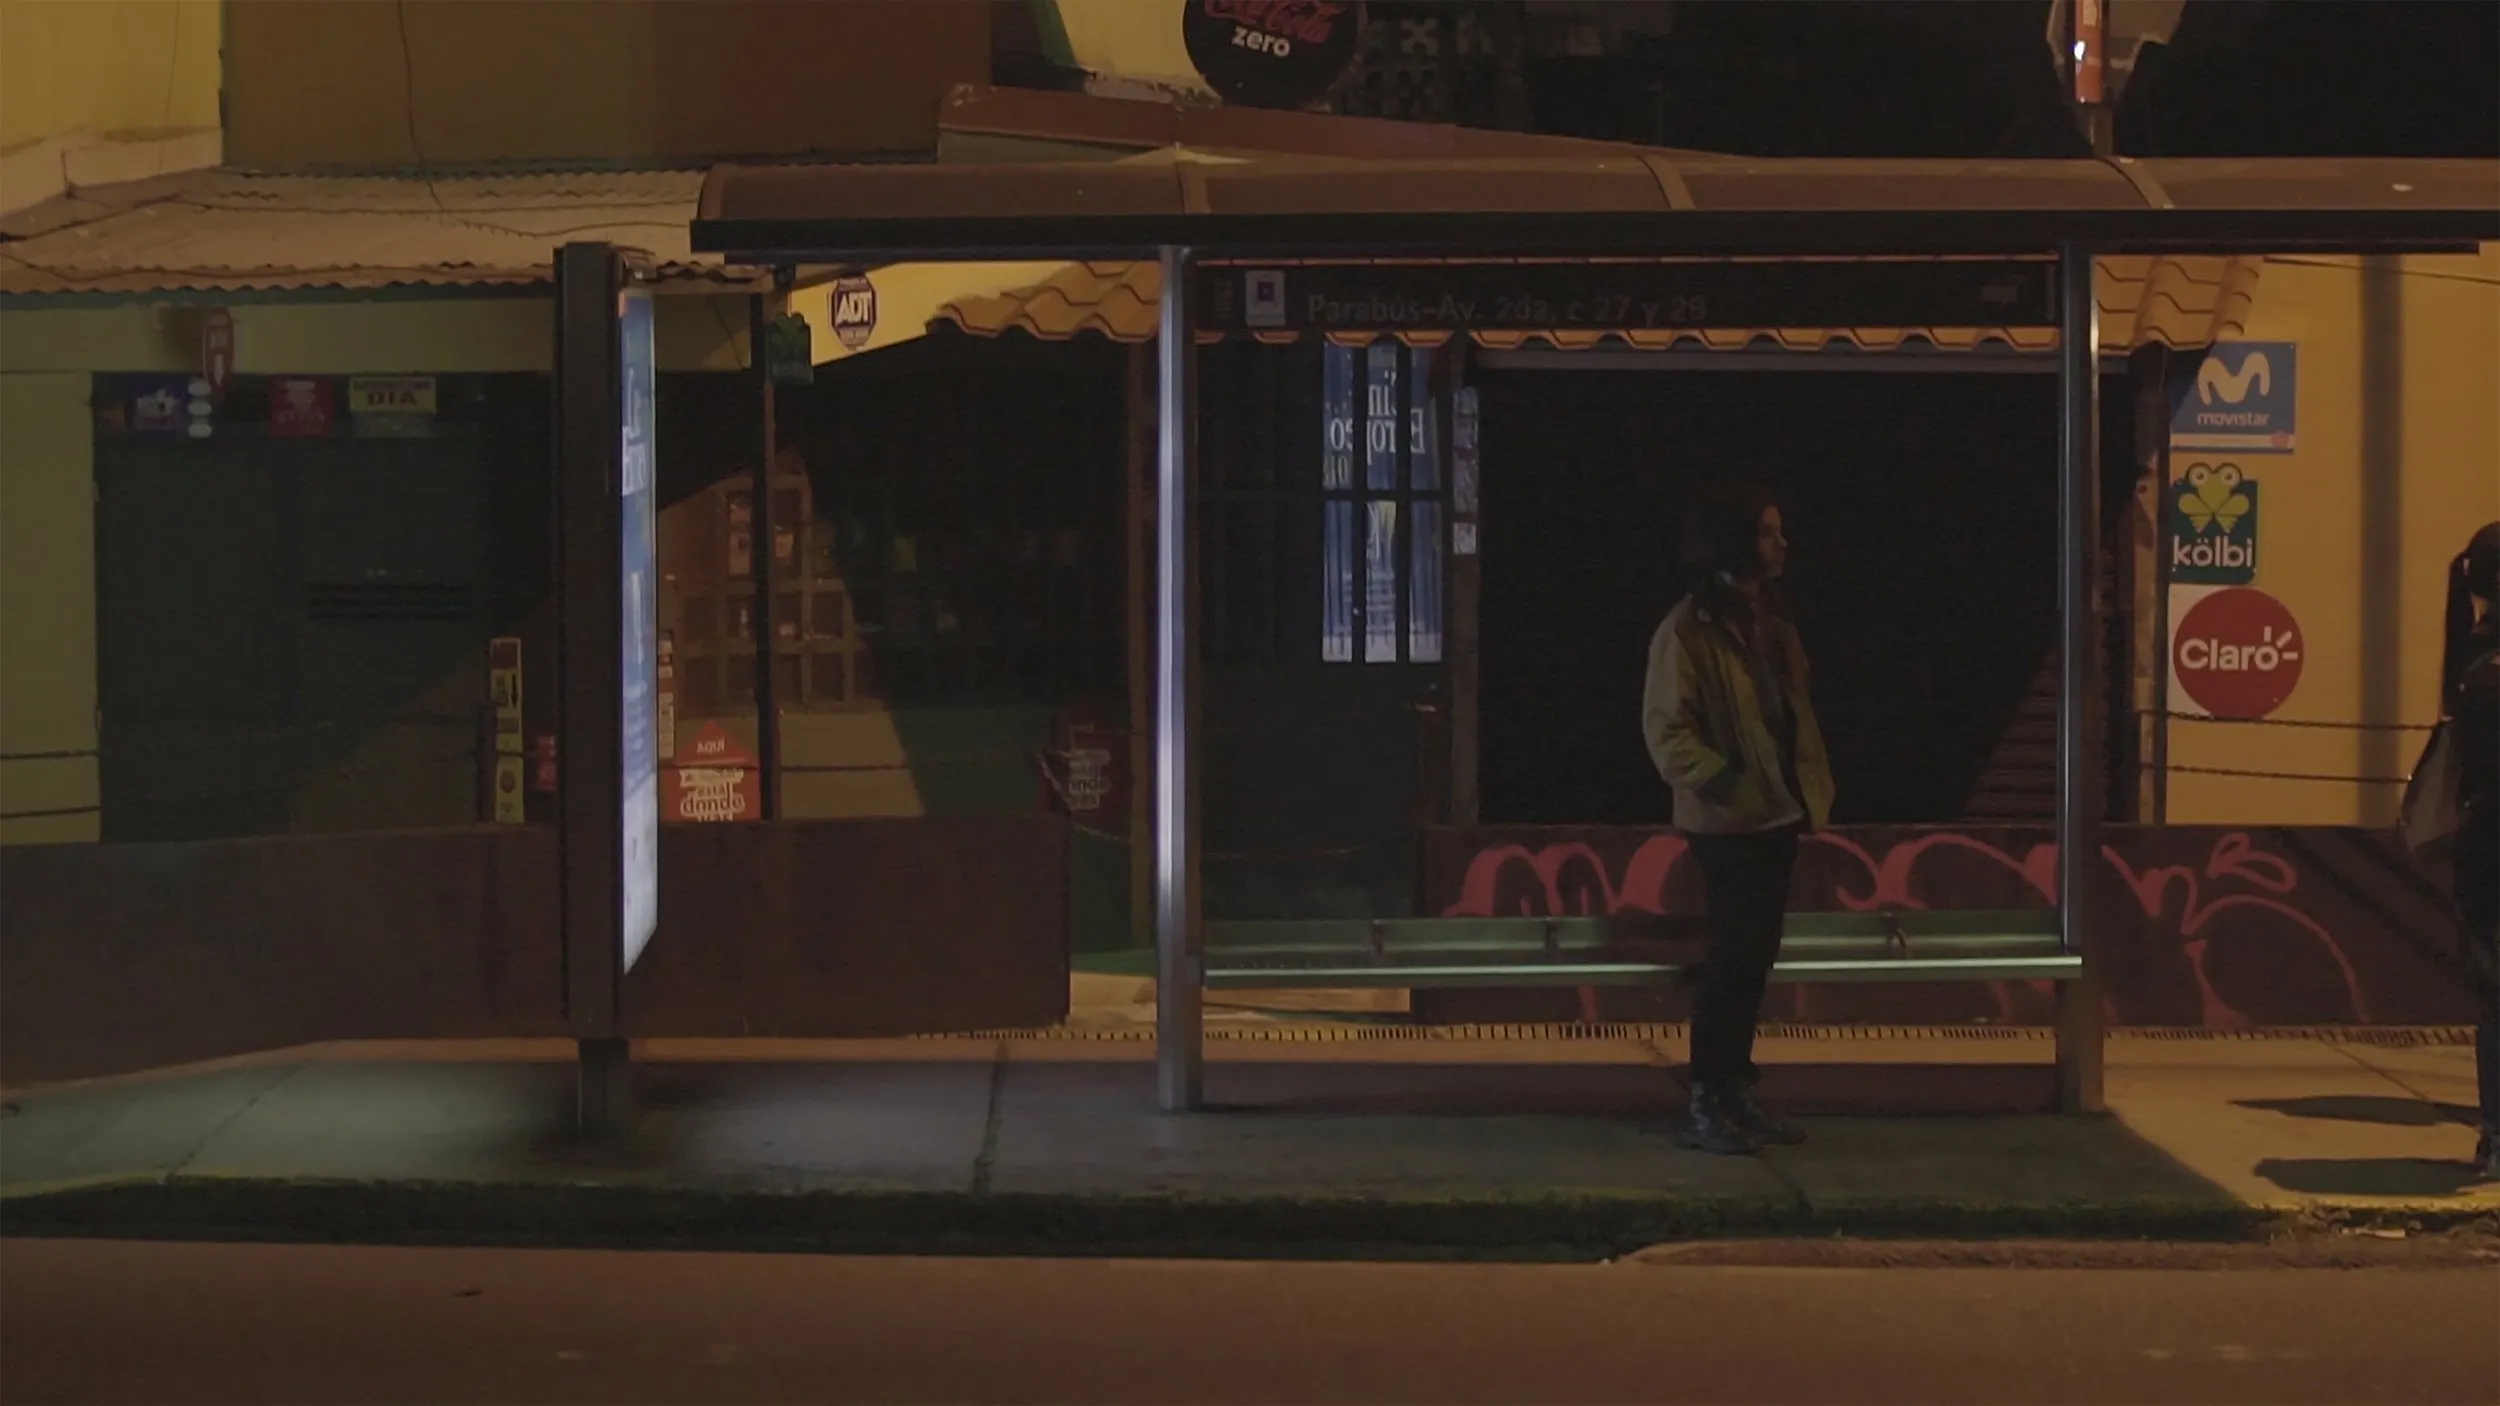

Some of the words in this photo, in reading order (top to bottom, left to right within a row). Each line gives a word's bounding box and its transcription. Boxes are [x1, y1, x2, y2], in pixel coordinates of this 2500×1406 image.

[1231, 25, 1291, 58] zero
[836, 291, 872, 324] ADT
[2197, 411, 2270, 427] movistar
[2172, 534, 2254, 568] kölbi
[2179, 637, 2280, 672] Claro
